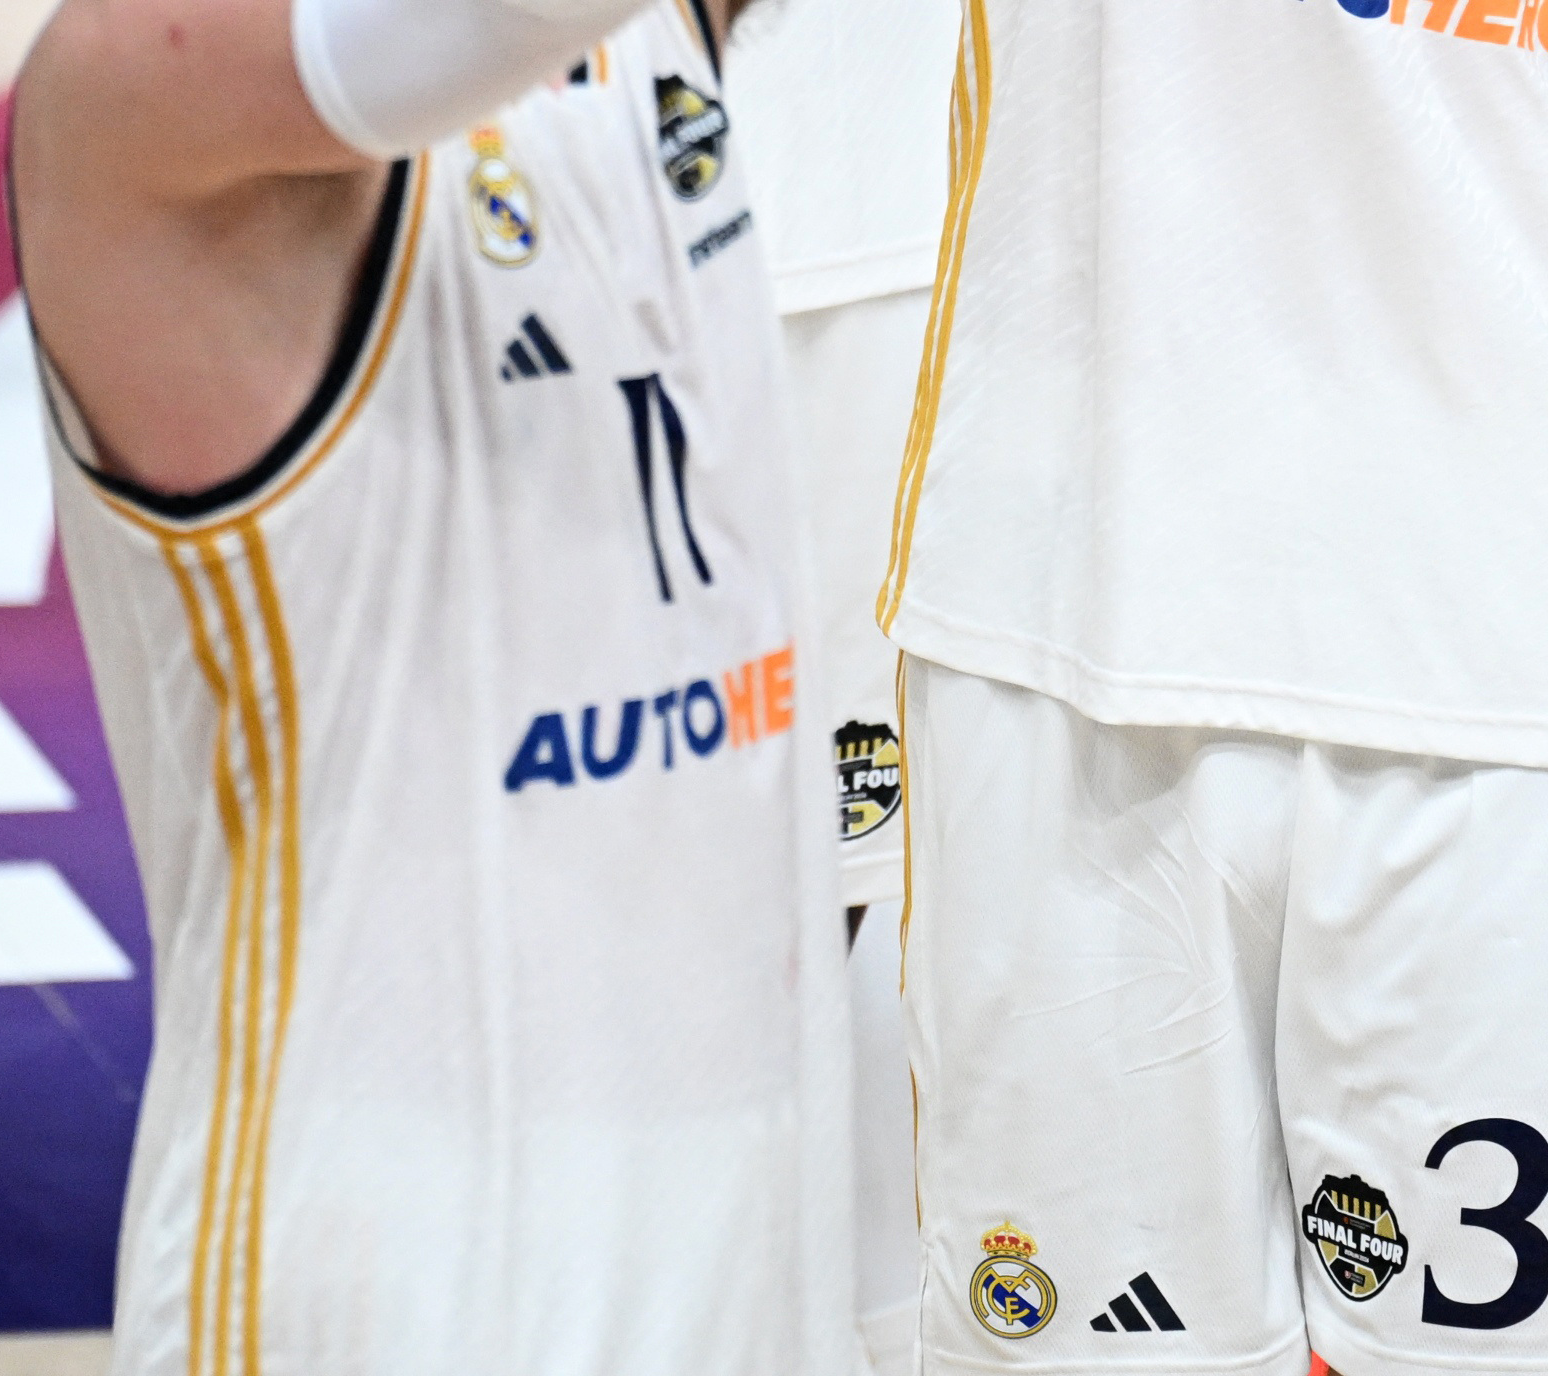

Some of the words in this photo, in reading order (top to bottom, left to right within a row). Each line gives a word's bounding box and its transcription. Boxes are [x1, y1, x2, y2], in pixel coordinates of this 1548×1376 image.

[617, 370, 715, 604] 11
[1306, 1214, 1357, 1250] FINAL
[1359, 1232, 1404, 1266] FOUR
